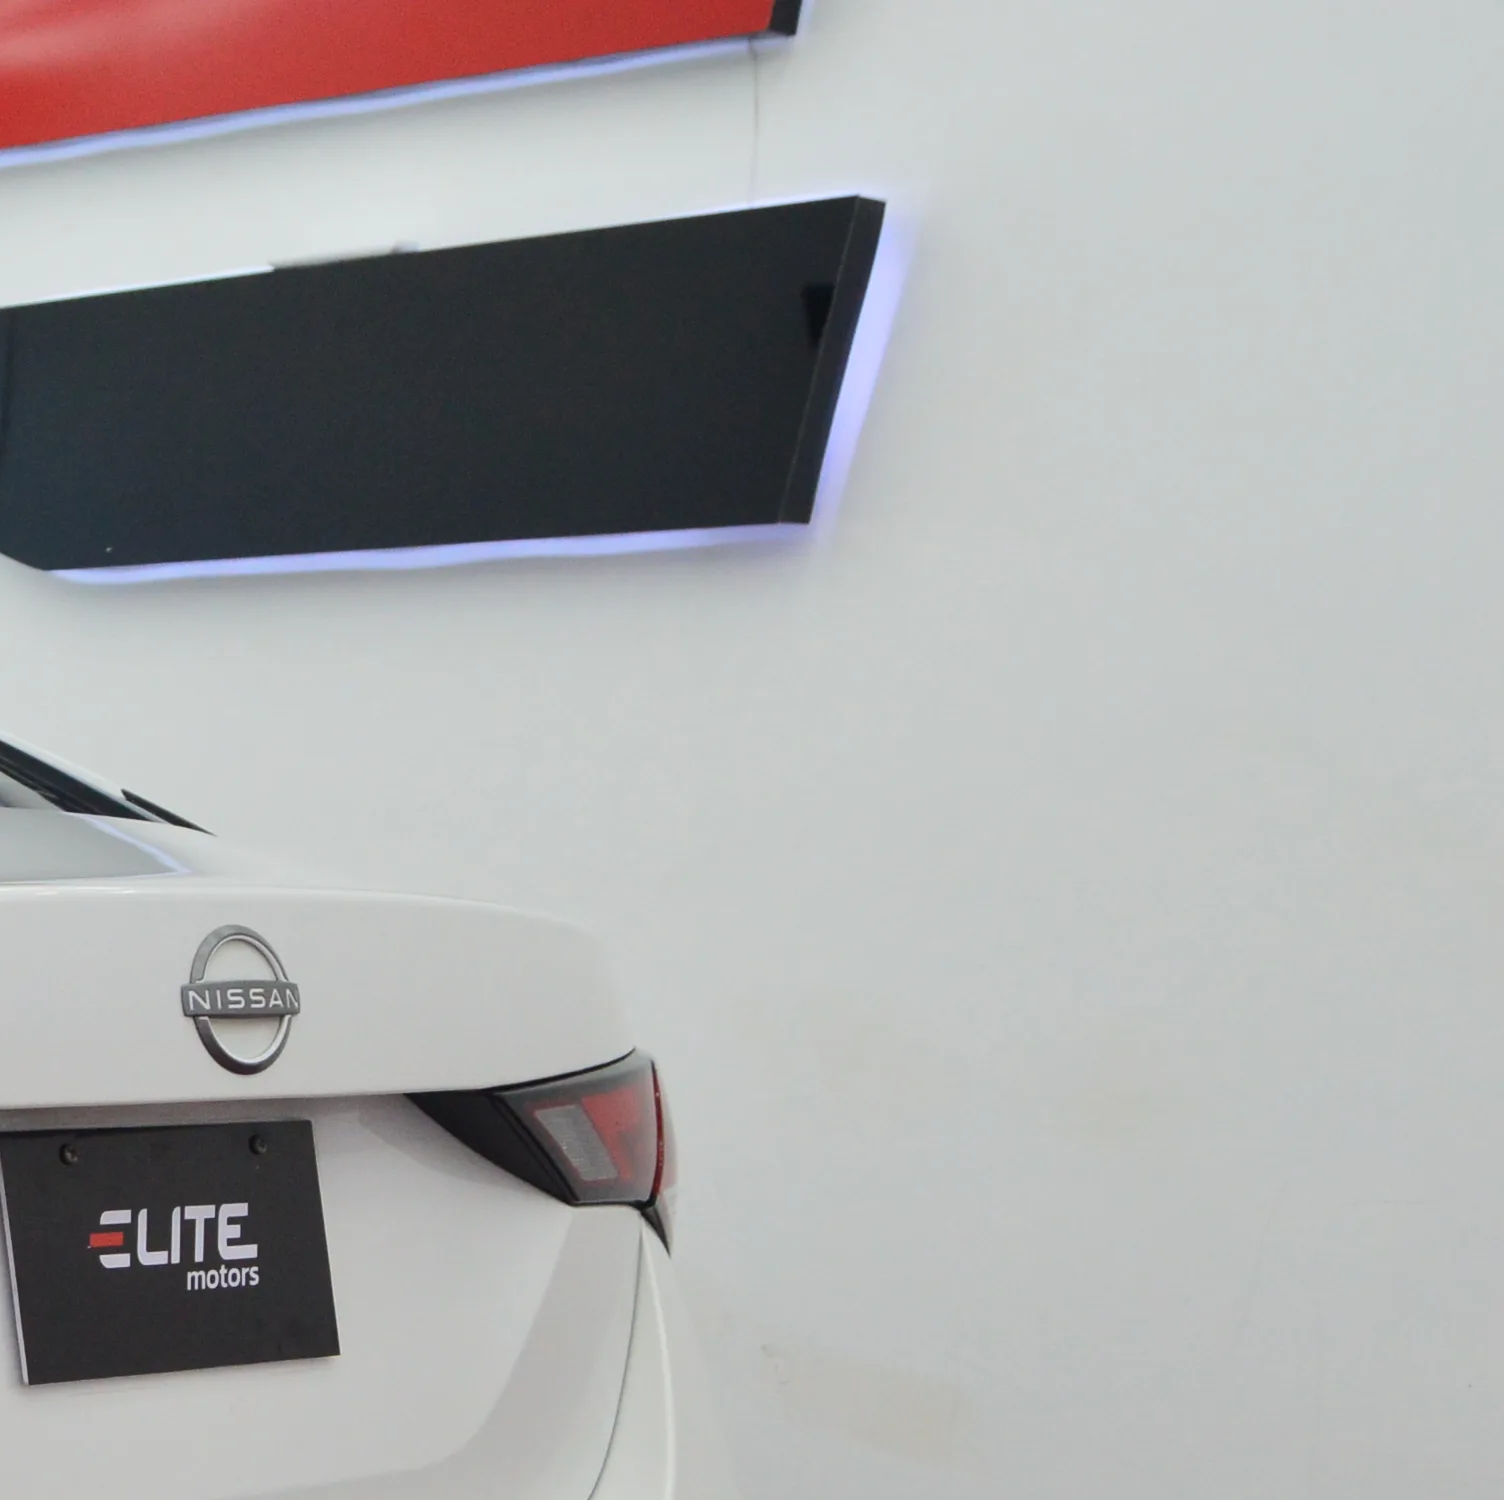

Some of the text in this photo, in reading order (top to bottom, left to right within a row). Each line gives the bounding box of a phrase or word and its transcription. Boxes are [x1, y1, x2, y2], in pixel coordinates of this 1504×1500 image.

[188, 988, 298, 1011] NISSAN
[89, 1202, 258, 1269] ELITE
[186, 1264, 260, 1291] motors
